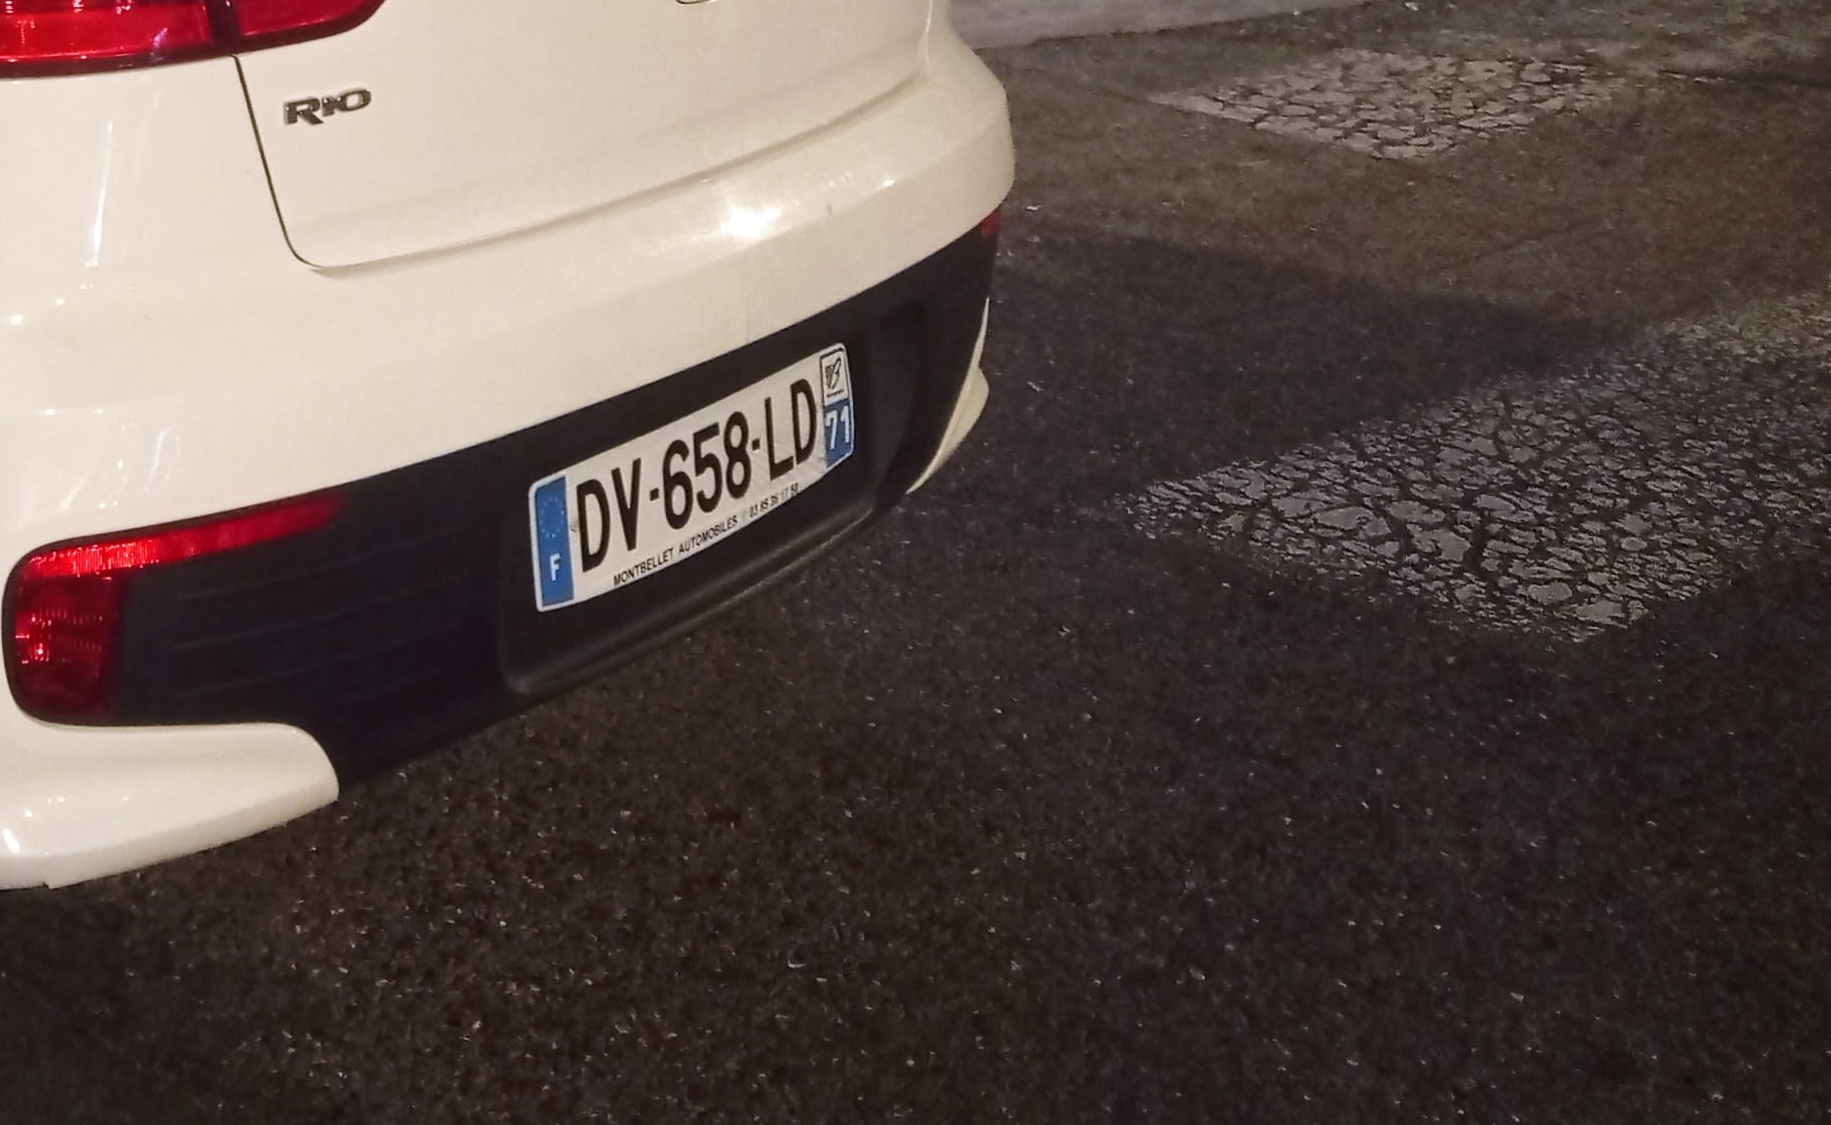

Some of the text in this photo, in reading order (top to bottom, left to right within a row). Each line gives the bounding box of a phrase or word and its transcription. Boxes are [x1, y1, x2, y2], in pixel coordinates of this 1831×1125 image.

[283, 89, 372, 125] RIO
[825, 405, 850, 450] 71
[576, 378, 817, 573] DV-658-LD
[550, 553, 561, 581] F
[613, 548, 674, 586] MONTBELLET
[678, 514, 738, 554] AUTOMOBILES
